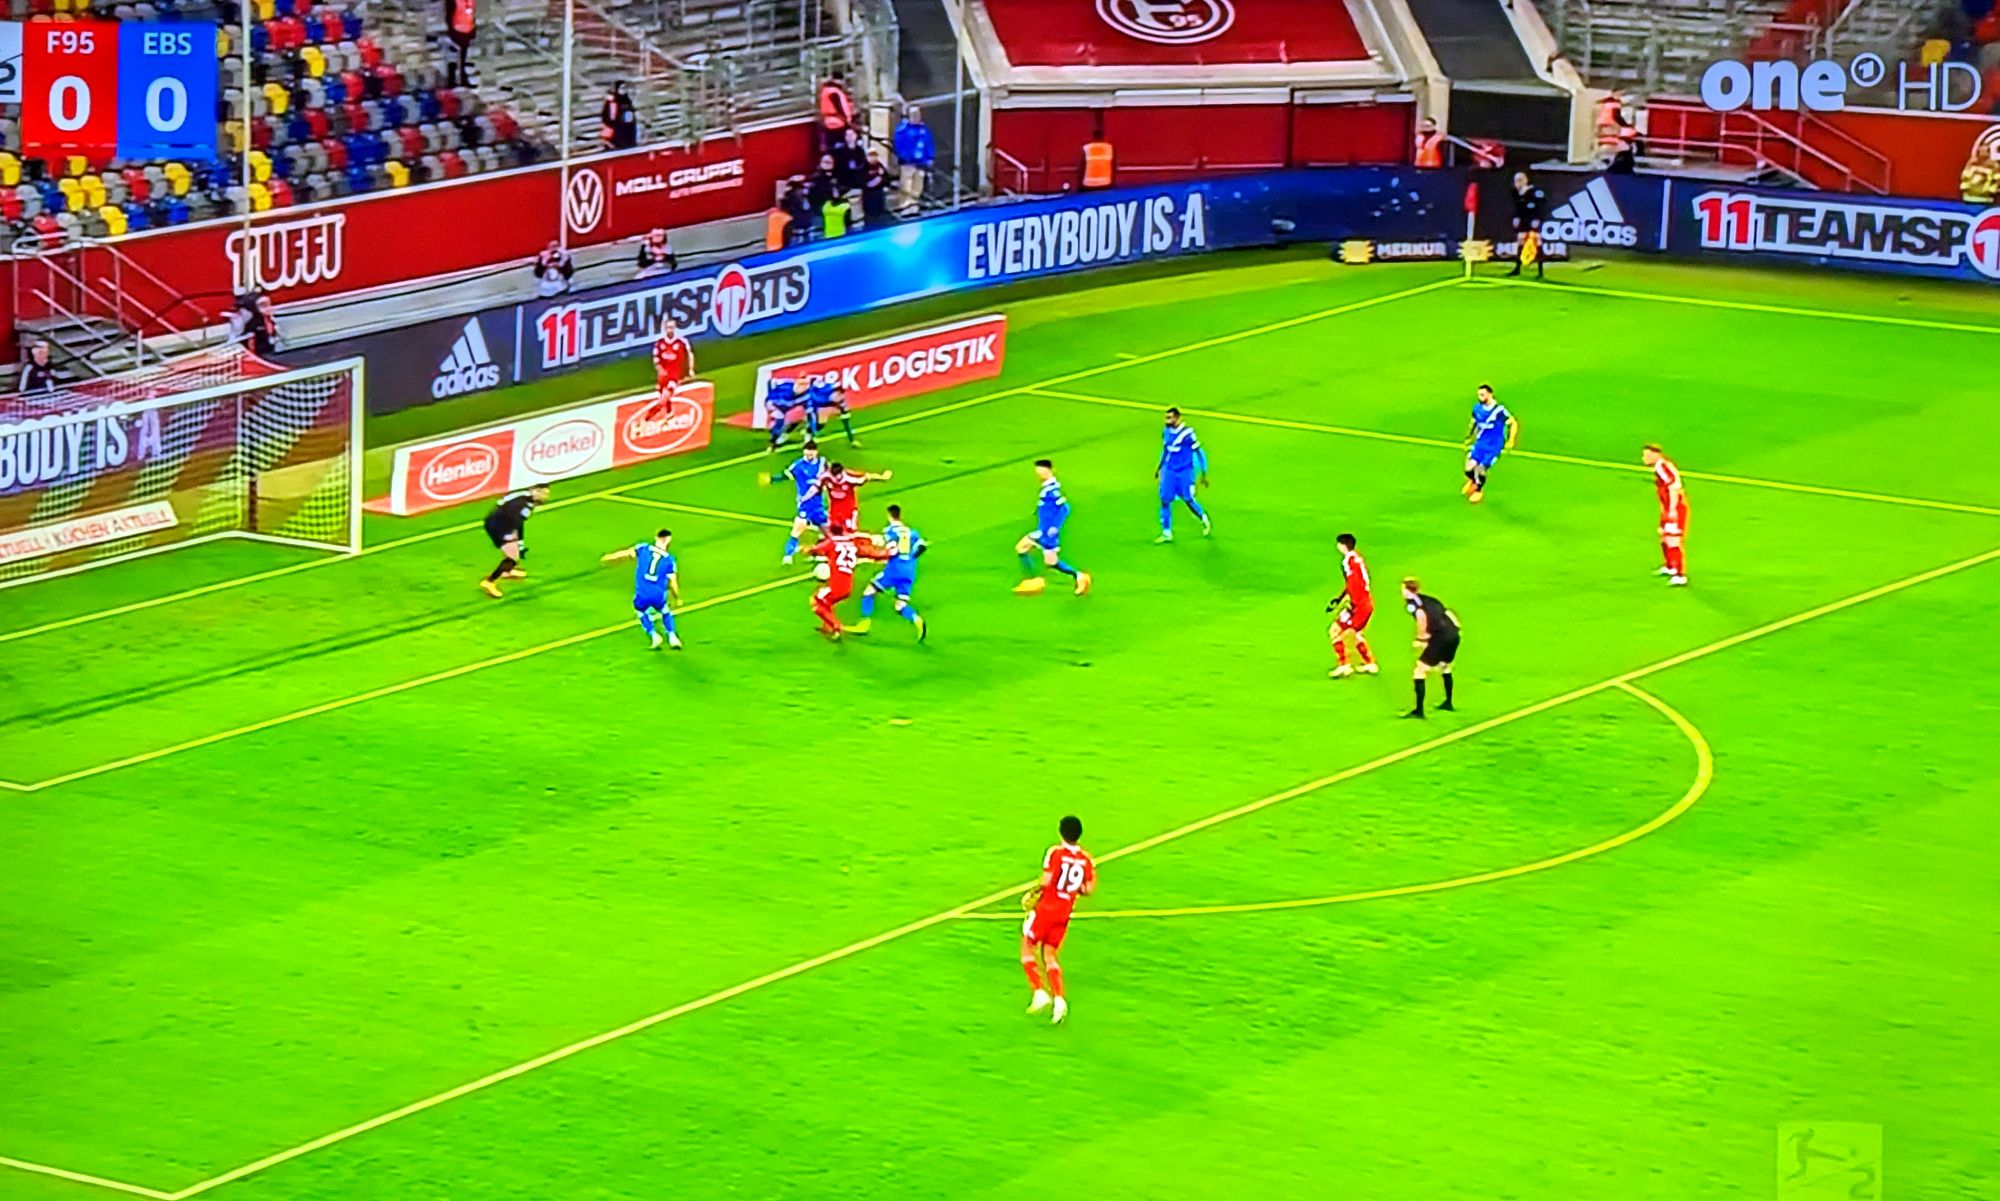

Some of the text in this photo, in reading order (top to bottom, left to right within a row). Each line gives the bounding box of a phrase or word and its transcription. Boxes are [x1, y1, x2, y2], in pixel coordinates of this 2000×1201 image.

[616, 174, 668, 196] MOLL
[668, 159, 745, 187] GRUPPE
[968, 193, 1205, 279] EVERYBODY IS A
[1541, 217, 1637, 247] adidas
[225, 213, 346, 297] TUFFI
[867, 334, 997, 389] LOGISTIK
[431, 364, 499, 399] adidas
[631, 407, 695, 440] Henkel
[530, 430, 597, 462] Henkel
[428, 454, 492, 487] Henkel
[834, 545, 857, 569] 23
[1056, 862, 1085, 892] 19
